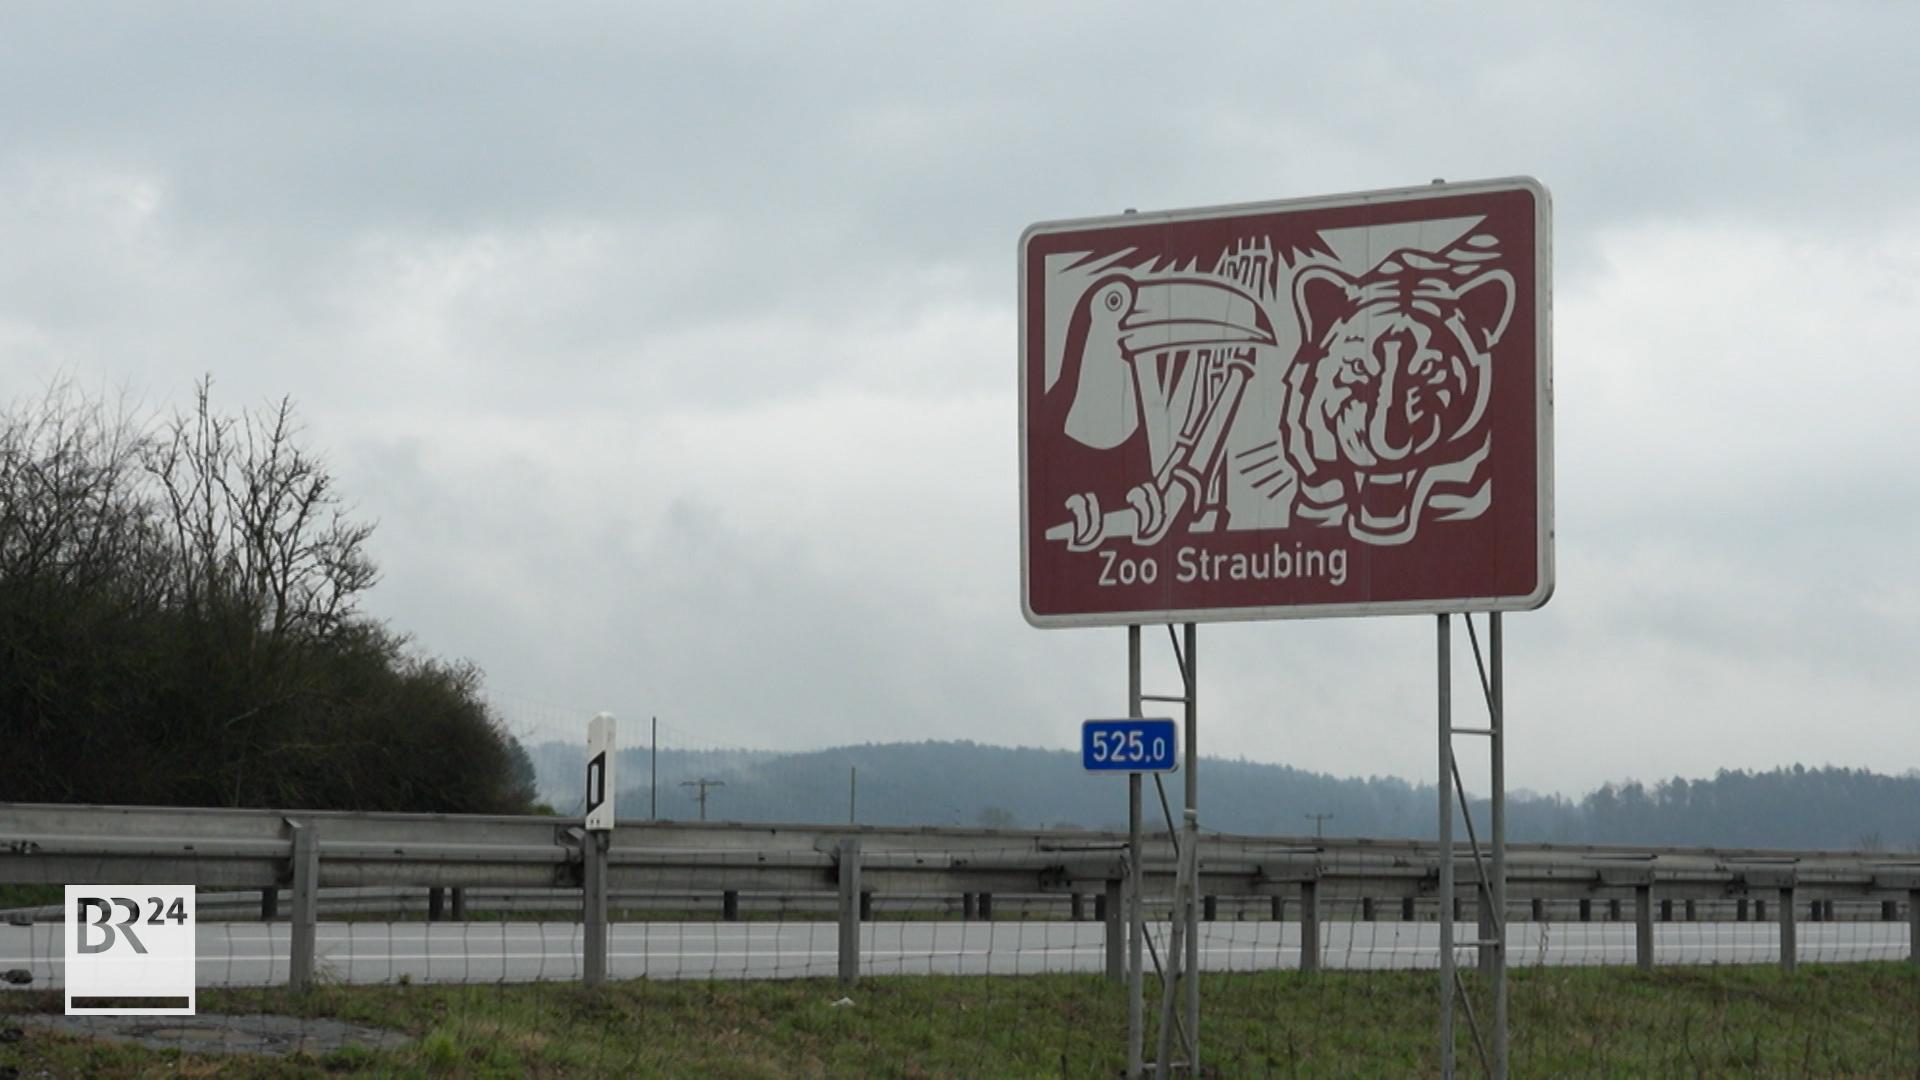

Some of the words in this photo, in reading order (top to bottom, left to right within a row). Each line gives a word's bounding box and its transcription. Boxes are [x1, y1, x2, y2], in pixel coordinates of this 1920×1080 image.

[1098, 551, 1157, 585] Zoo
[1176, 542, 1346, 585] Straubing
[1092, 730, 1165, 763] 525,0
